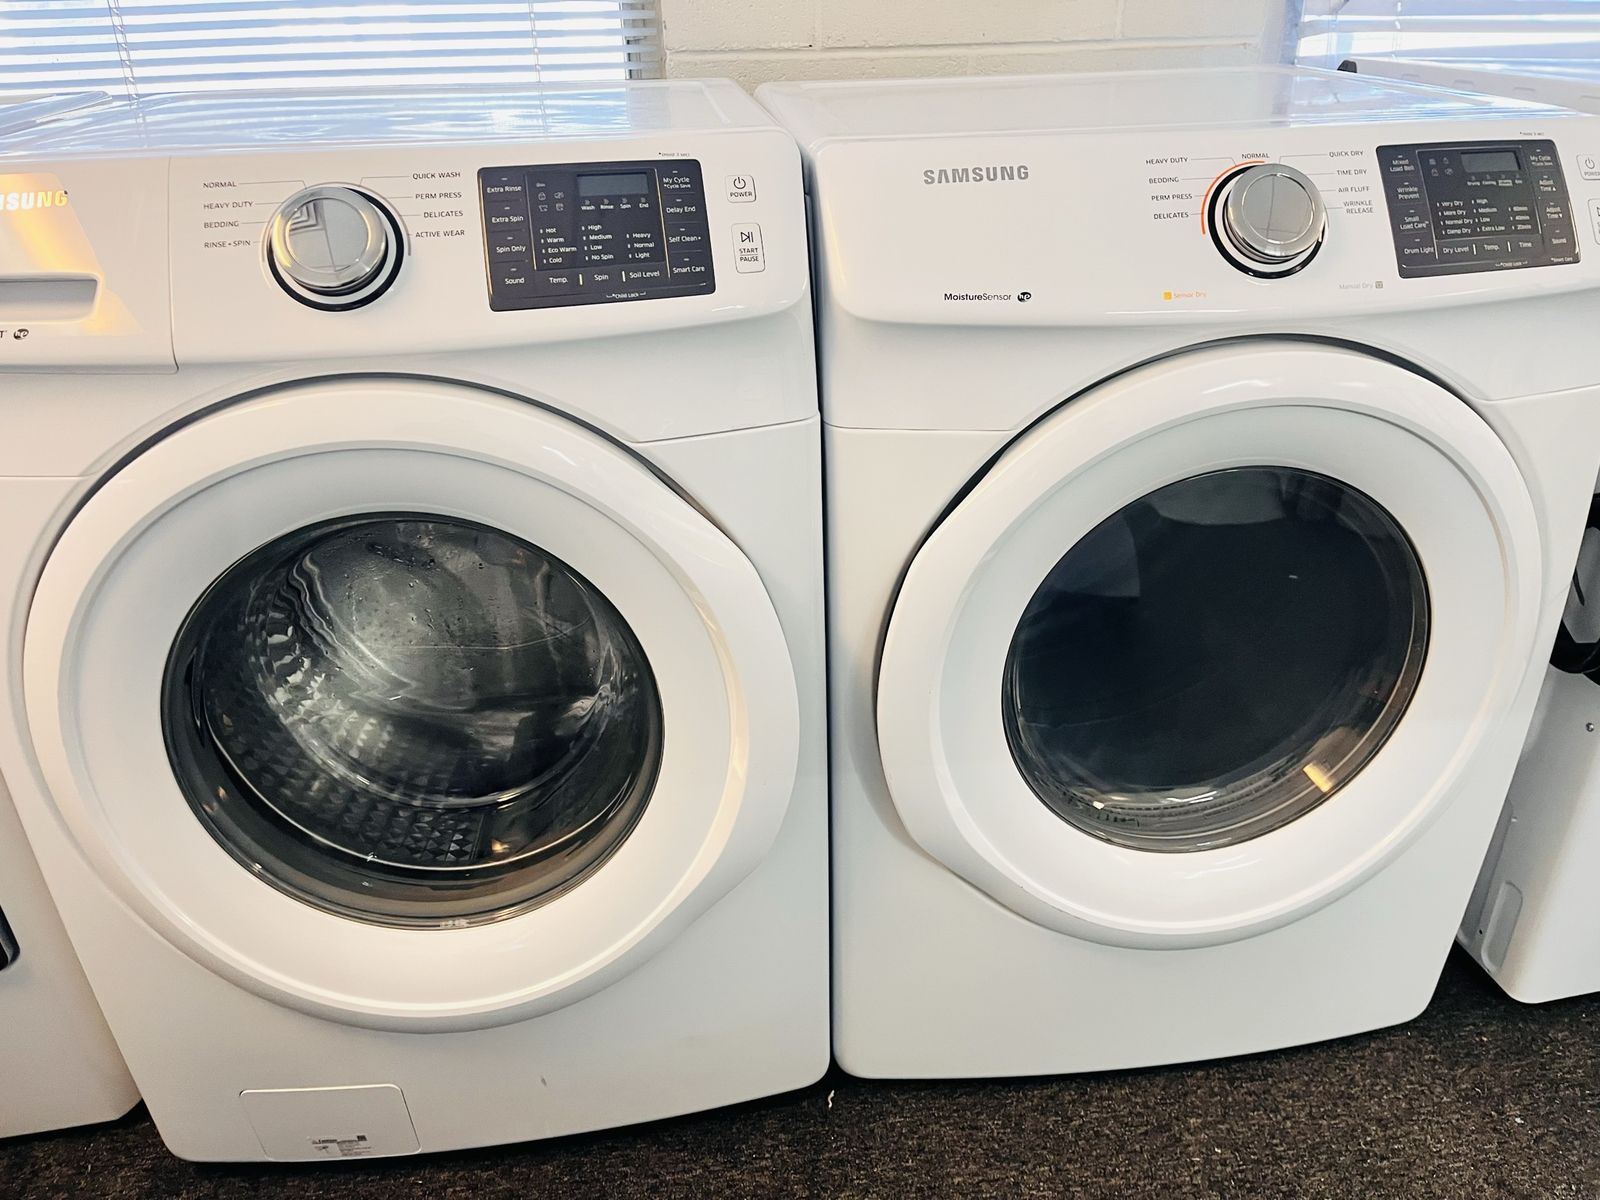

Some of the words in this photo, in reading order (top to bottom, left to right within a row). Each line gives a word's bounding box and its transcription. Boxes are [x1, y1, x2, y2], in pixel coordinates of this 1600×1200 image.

[923, 165, 1029, 185] SAMSUNG
[203, 181, 237, 189] NORMAL
[423, 210, 463, 218] DELICATES
[1153, 212, 1189, 220] DELICATES
[509, 215, 524, 223] Spin
[203, 221, 239, 229] BEDDING
[511, 245, 526, 253] Only
[944, 292, 1012, 301] MoistureSensor
